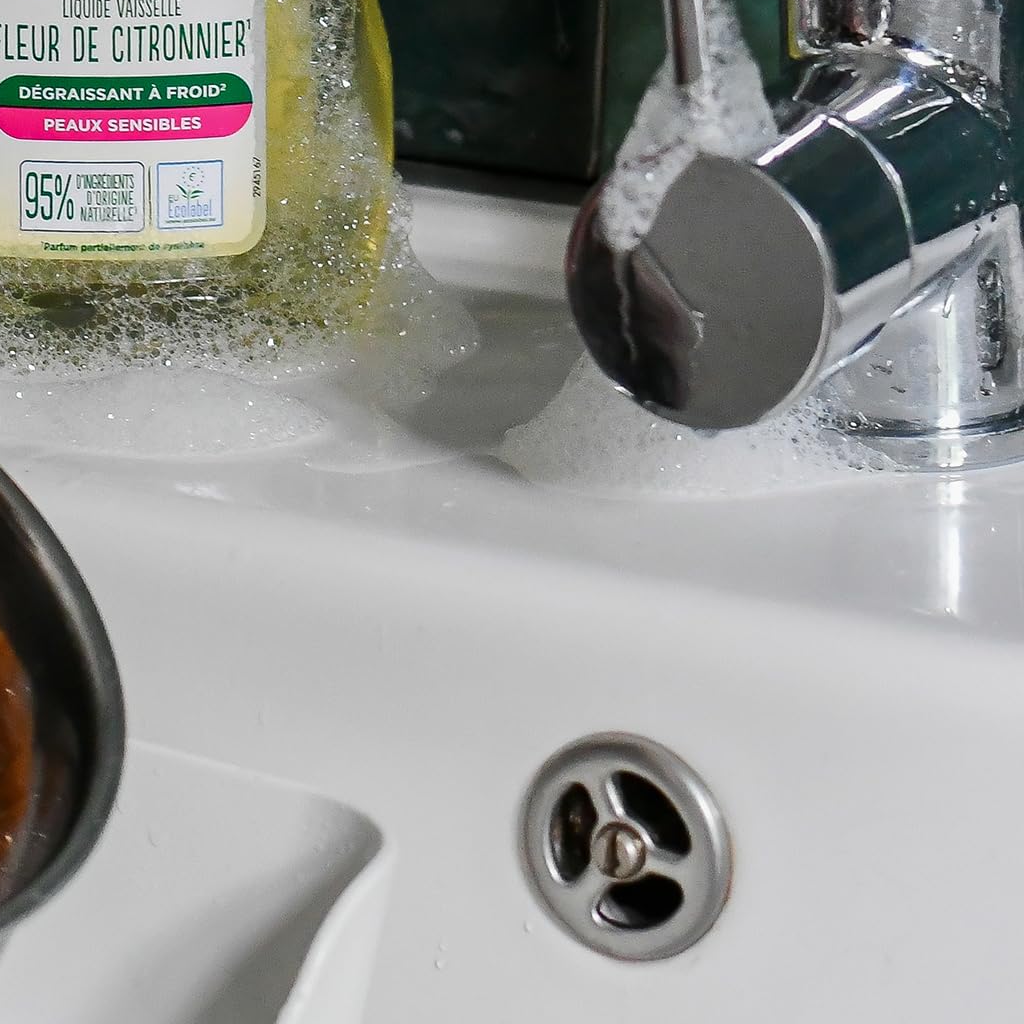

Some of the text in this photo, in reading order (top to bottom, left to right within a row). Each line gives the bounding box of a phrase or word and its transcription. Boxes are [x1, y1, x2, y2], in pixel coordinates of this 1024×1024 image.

[73, 25, 100, 63] DE
[18, 83, 144, 101] DÉGRAISSANT
[148, 83, 162, 101] À
[43, 116, 202, 132] PEAUX SENSIBLES
[24, 171, 74, 220] 95%
[86, 190, 134, 206] D'ORIGINE
